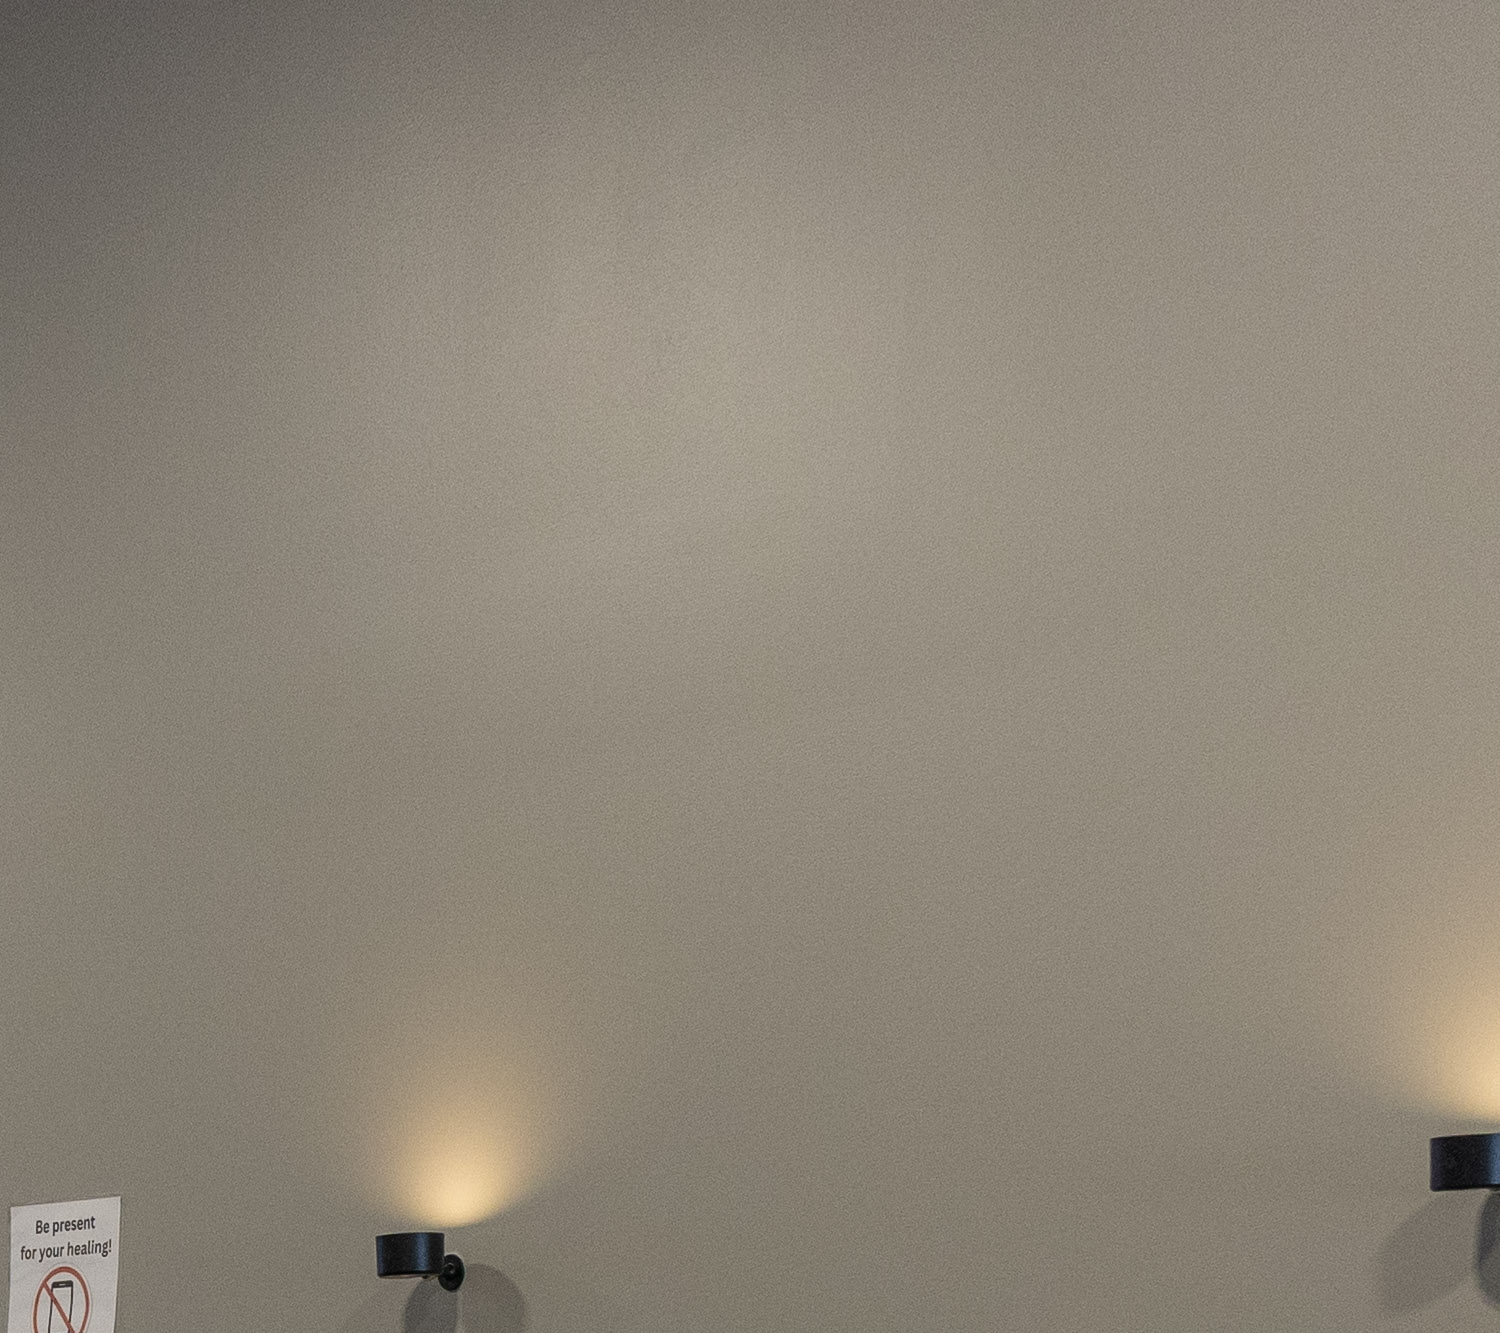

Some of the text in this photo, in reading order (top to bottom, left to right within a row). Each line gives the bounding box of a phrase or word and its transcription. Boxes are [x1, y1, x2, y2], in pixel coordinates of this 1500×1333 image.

[36, 1216, 95, 1236] Be present
[21, 1239, 112, 1263] for your healing!
